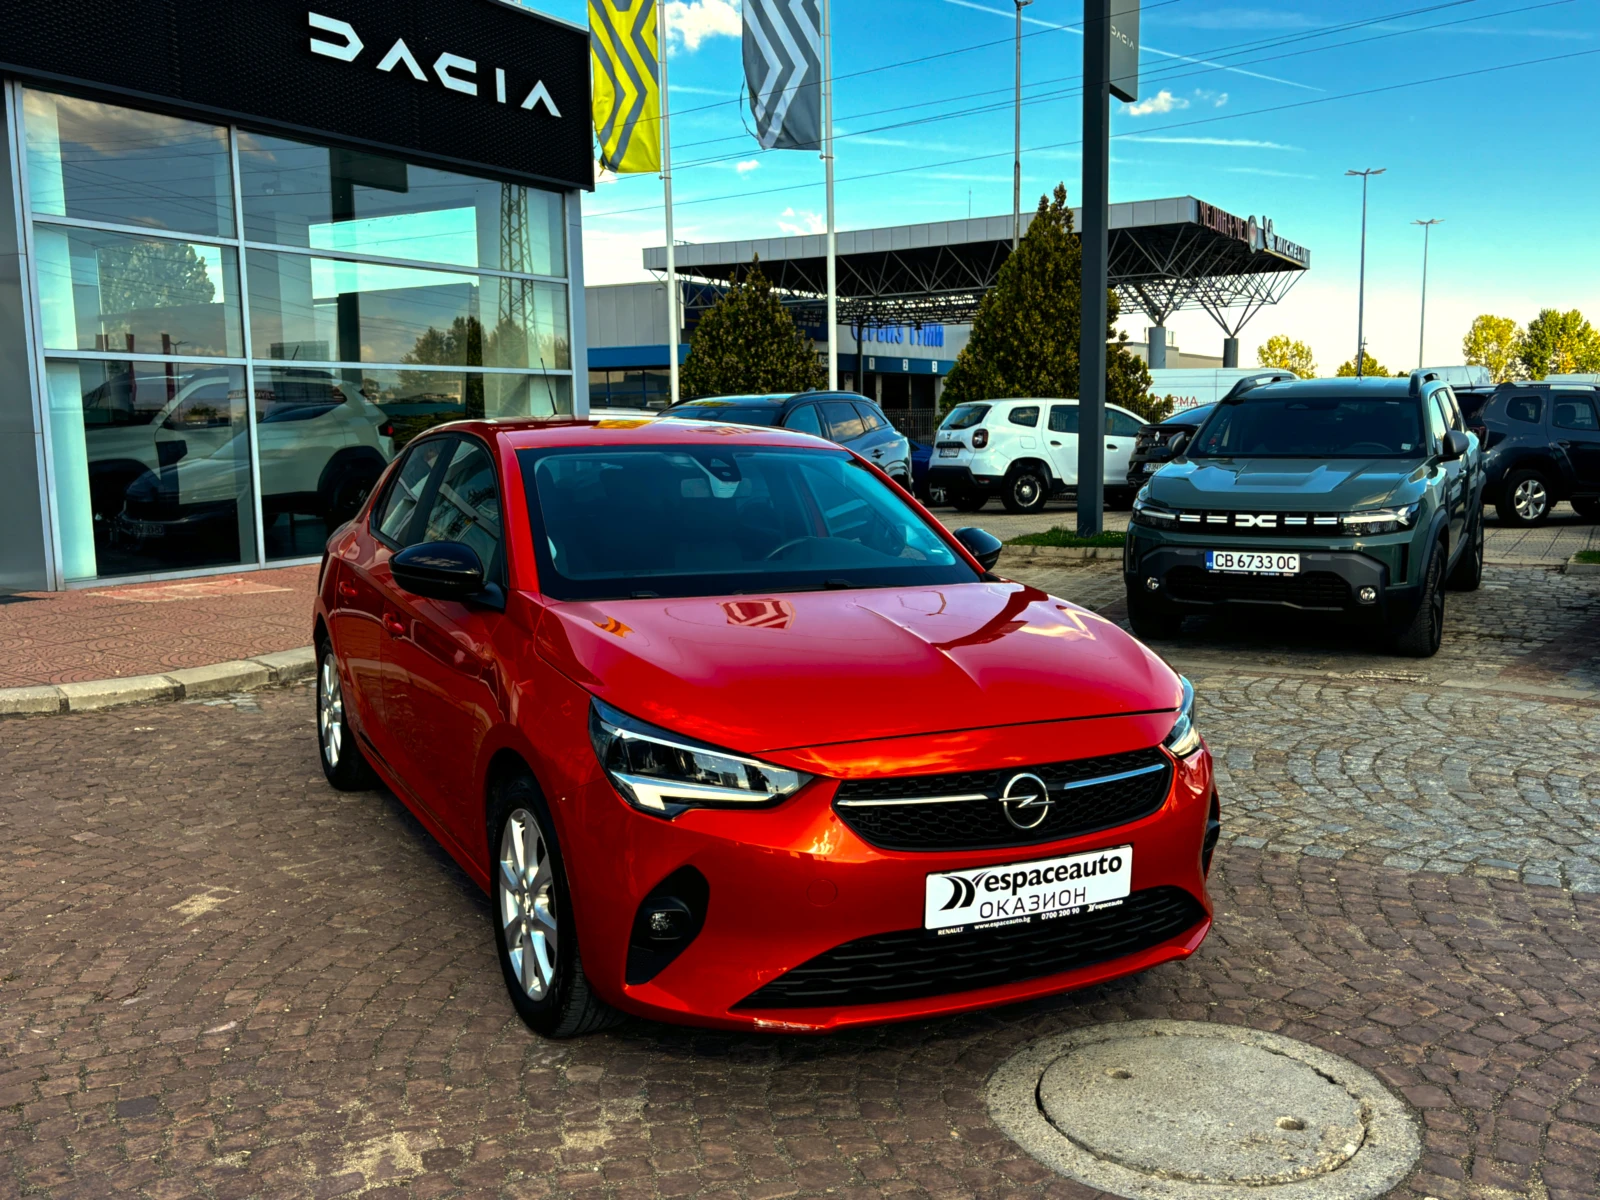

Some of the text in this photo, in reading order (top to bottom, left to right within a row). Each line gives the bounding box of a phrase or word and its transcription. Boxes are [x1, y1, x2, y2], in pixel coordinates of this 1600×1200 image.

[1110, 24, 1135, 51] DACIA
[308, 11, 562, 118] DACIA
[1276, 235, 1307, 262] MICHELIN
[1215, 553, 1234, 568] CB
[1237, 554, 1273, 570] 6733
[984, 854, 1123, 896] espaceauto
[979, 886, 1087, 919] ОКАЗИОН
[1041, 907, 1080, 920] 0700 200 90
[1094, 899, 1124, 911] espaceauto
[937, 926, 964, 936] RENAULT
[974, 915, 1031, 930] www.espaceauto.bg
